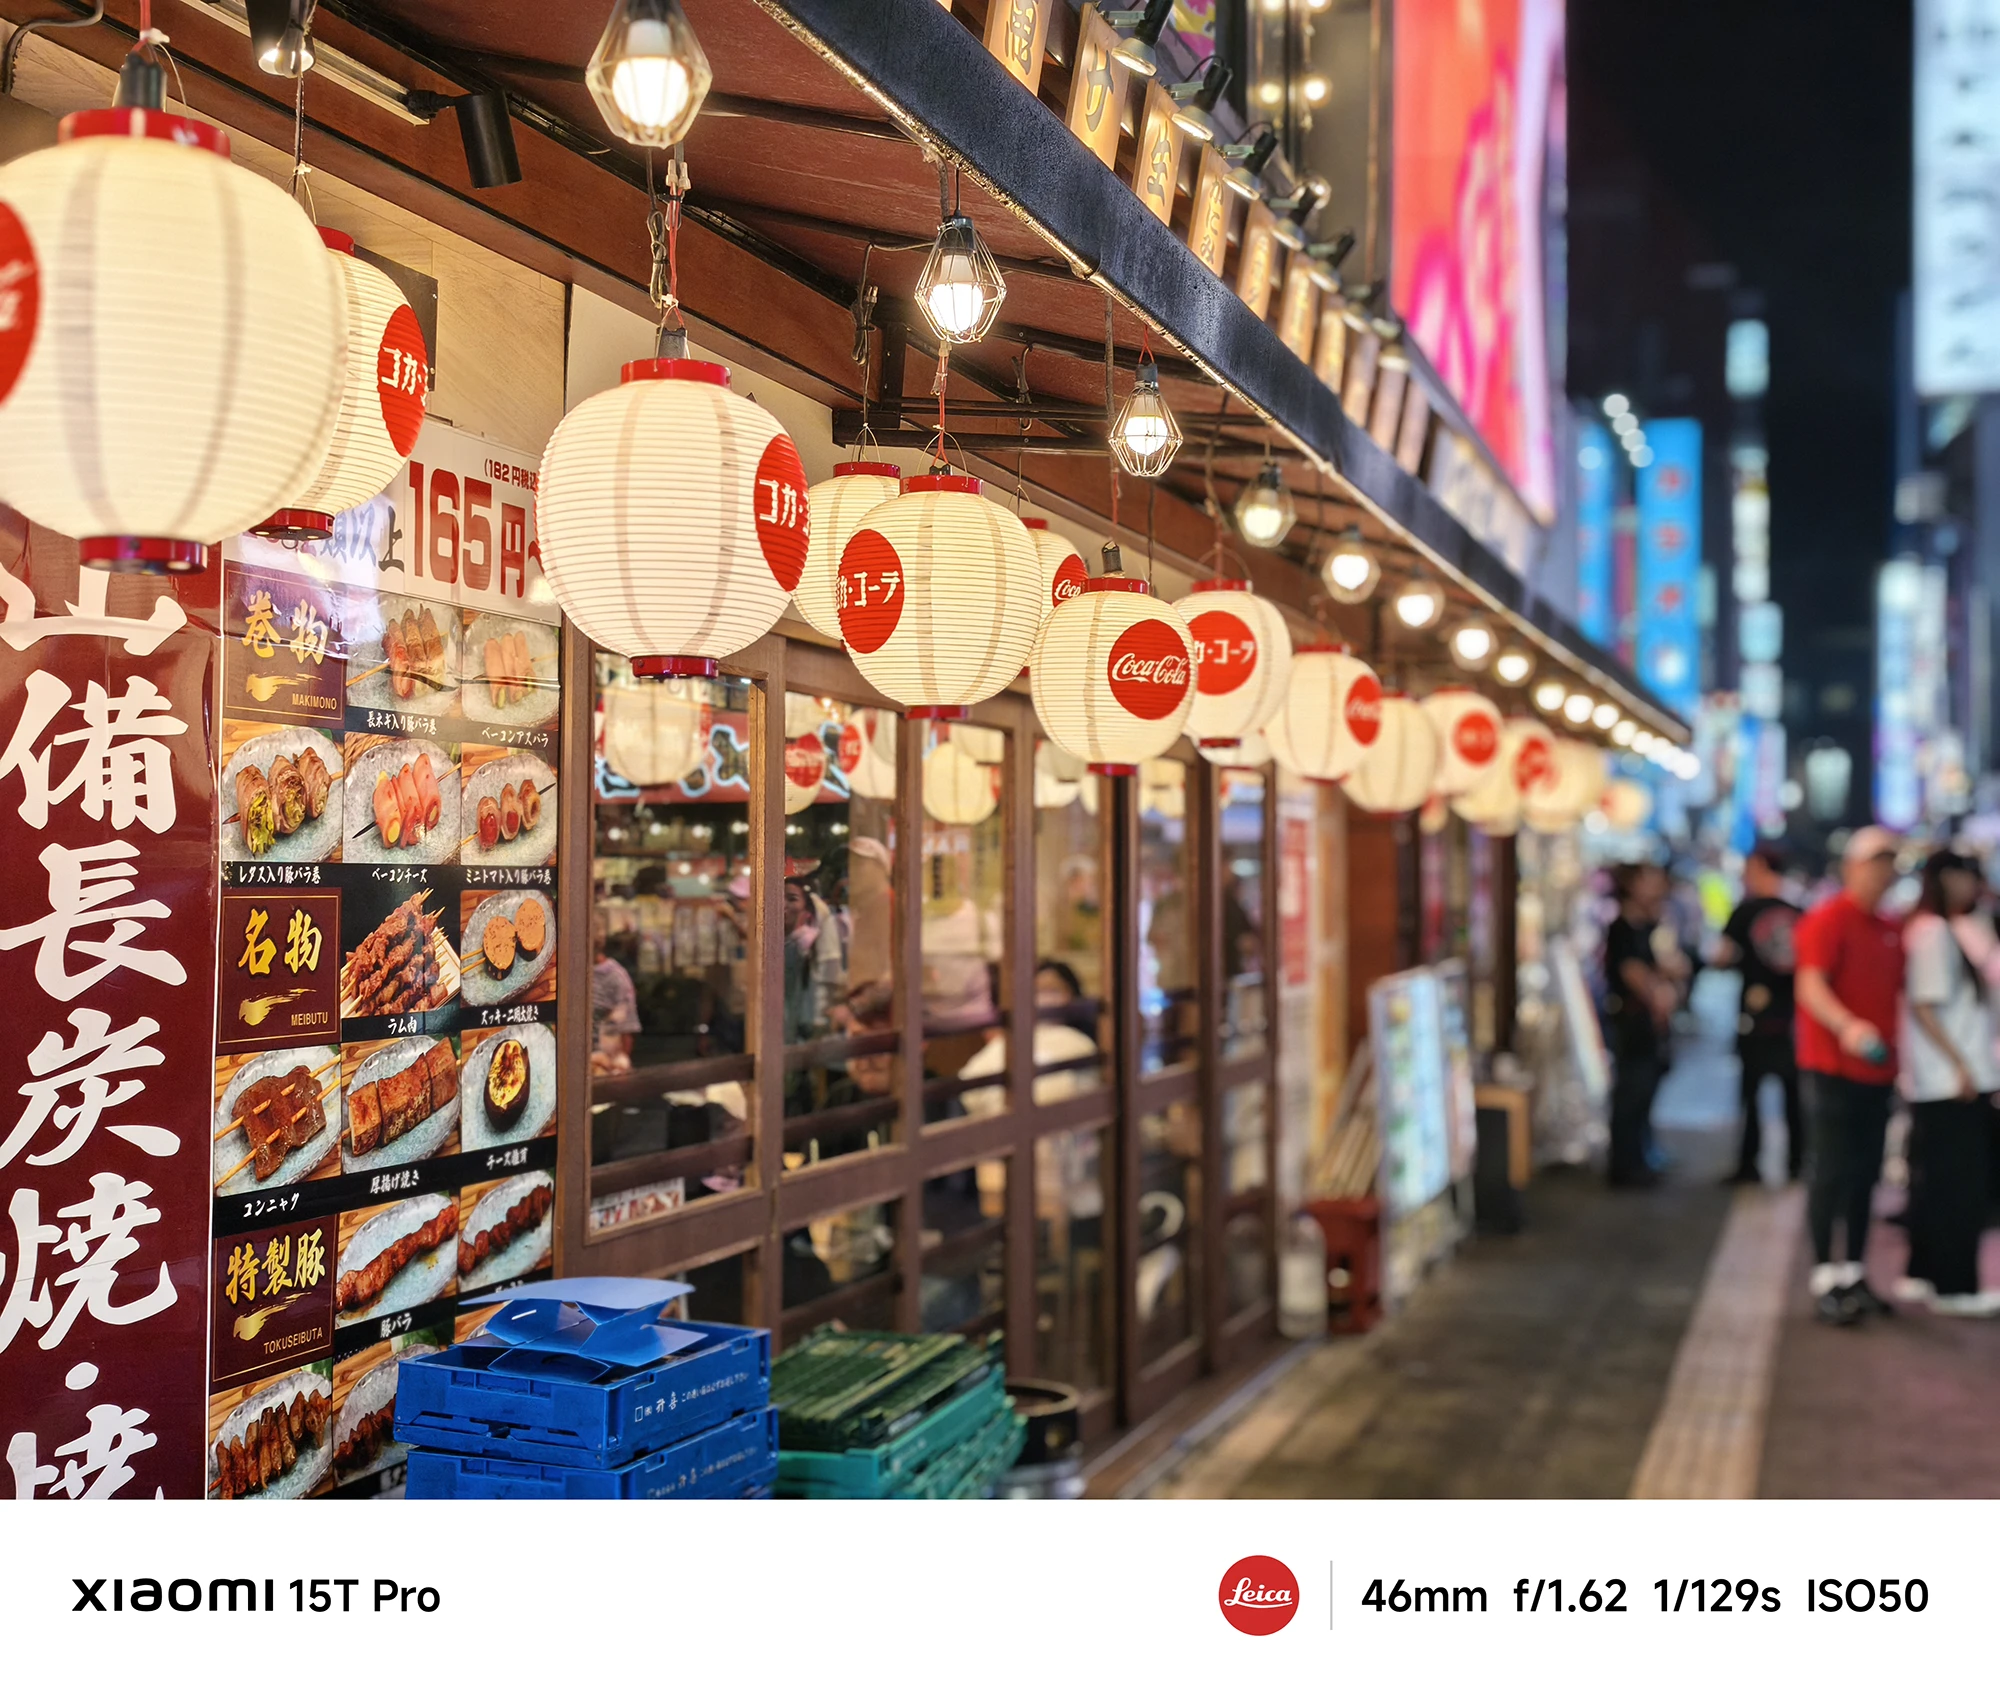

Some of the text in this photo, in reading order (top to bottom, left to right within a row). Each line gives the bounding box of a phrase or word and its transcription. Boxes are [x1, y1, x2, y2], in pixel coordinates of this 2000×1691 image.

[291, 693, 337, 710] MAKIMONO
[371, 867, 429, 883] ベーコンチーズ
[466, 867, 552, 886] ミニトマト入り豚バラ巻
[238, 908, 323, 975] 名物
[291, 1011, 328, 1026] MEIBUTU
[387, 1016, 417, 1035] ラム肉
[370, 1169, 420, 1195] 厚揚げ焼き
[242, 1192, 301, 1219] コンニャク
[225, 1228, 326, 1305] 特製豚
[380, 1312, 412, 1339] 豚バラ
[263, 1326, 324, 1355] TOKUSEIBUTA
